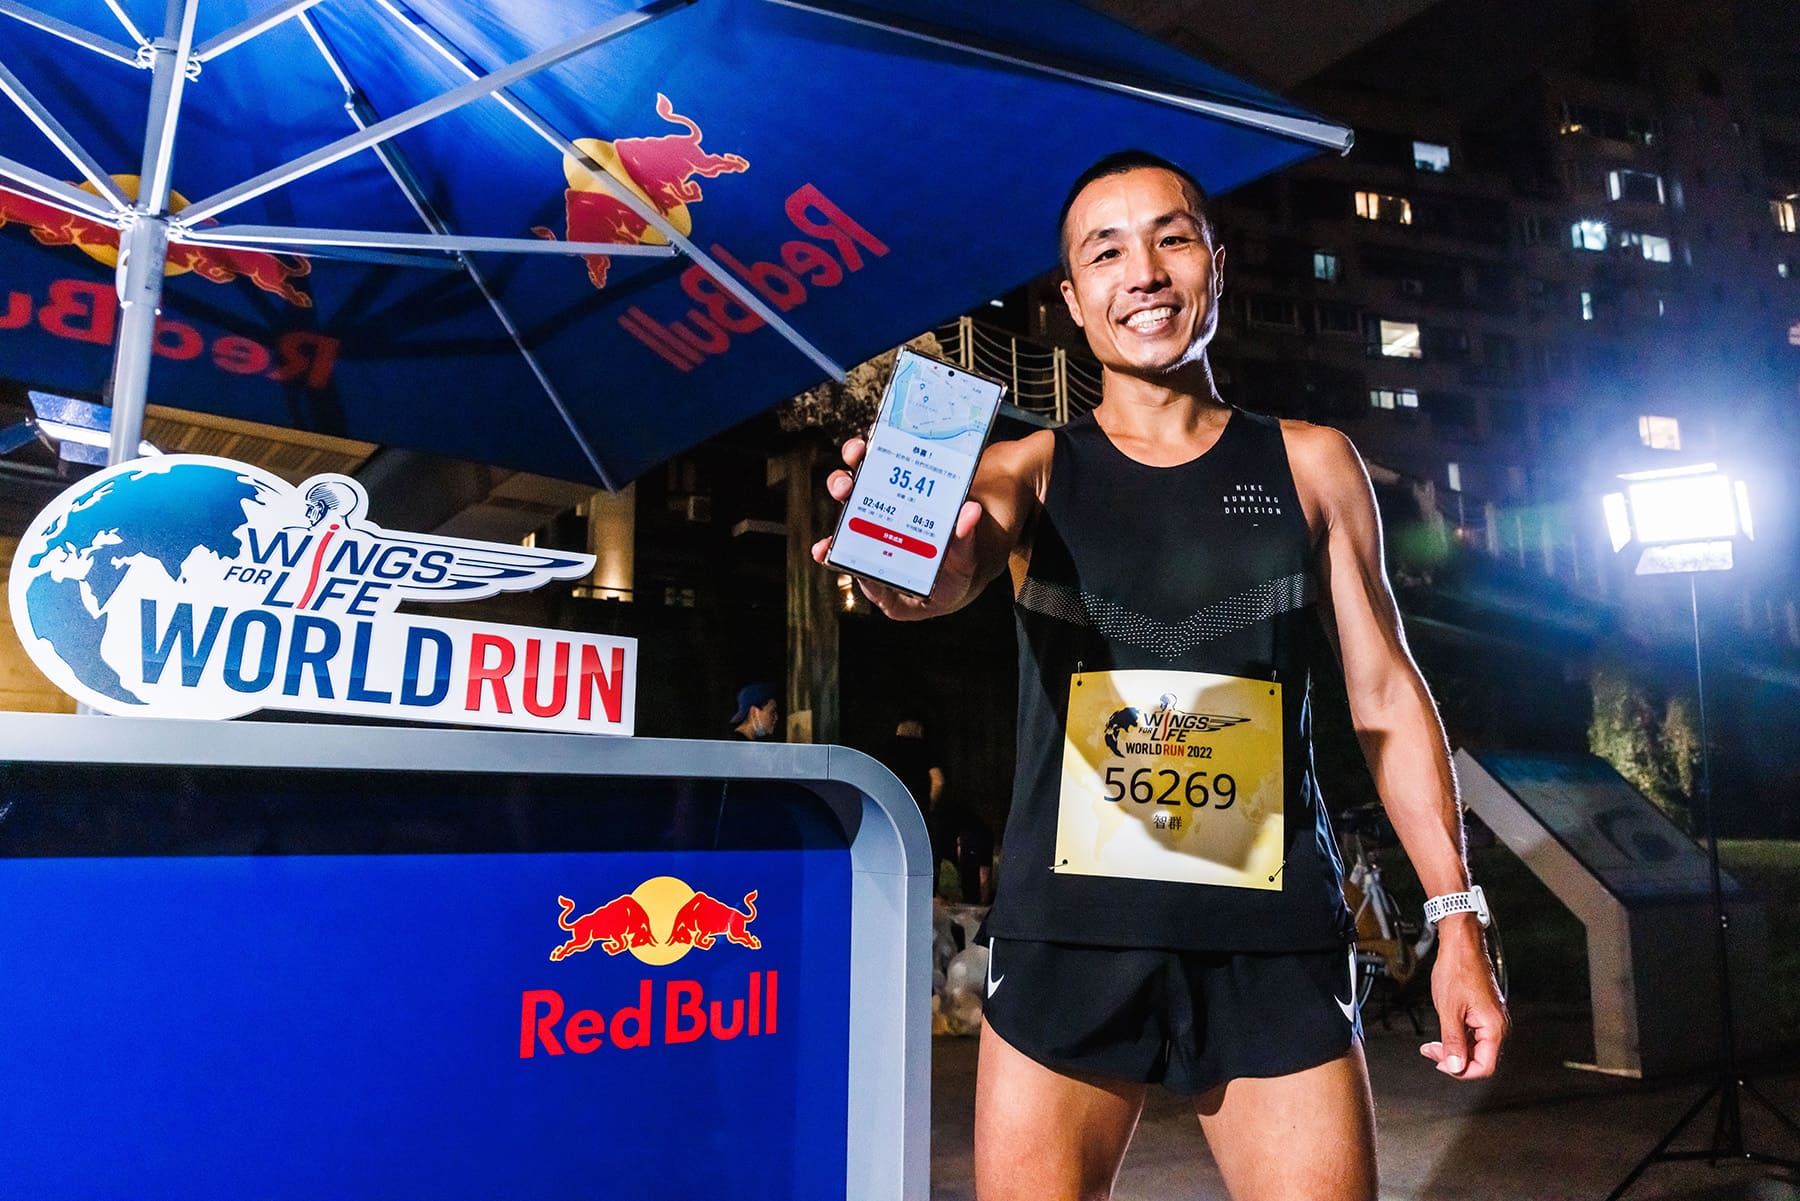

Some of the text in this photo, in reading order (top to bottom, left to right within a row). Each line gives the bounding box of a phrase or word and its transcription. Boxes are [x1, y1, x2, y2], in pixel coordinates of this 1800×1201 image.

[889, 466, 936, 498] 35.41
[862, 496, 897, 516] 02:44:42
[912, 514, 935, 530] 04:39
[1225, 506, 1281, 515] DIVISION
[223, 565, 393, 617] FOR LIFE
[141, 598, 625, 724] WORLD RUN
[1125, 742, 1213, 759] WORLD RUN 2022
[1150, 728, 1191, 743] LIFE
[1103, 767, 1237, 810] 56269
[1153, 814, 1183, 831] 智群
[519, 970, 778, 1059] Red Bull
